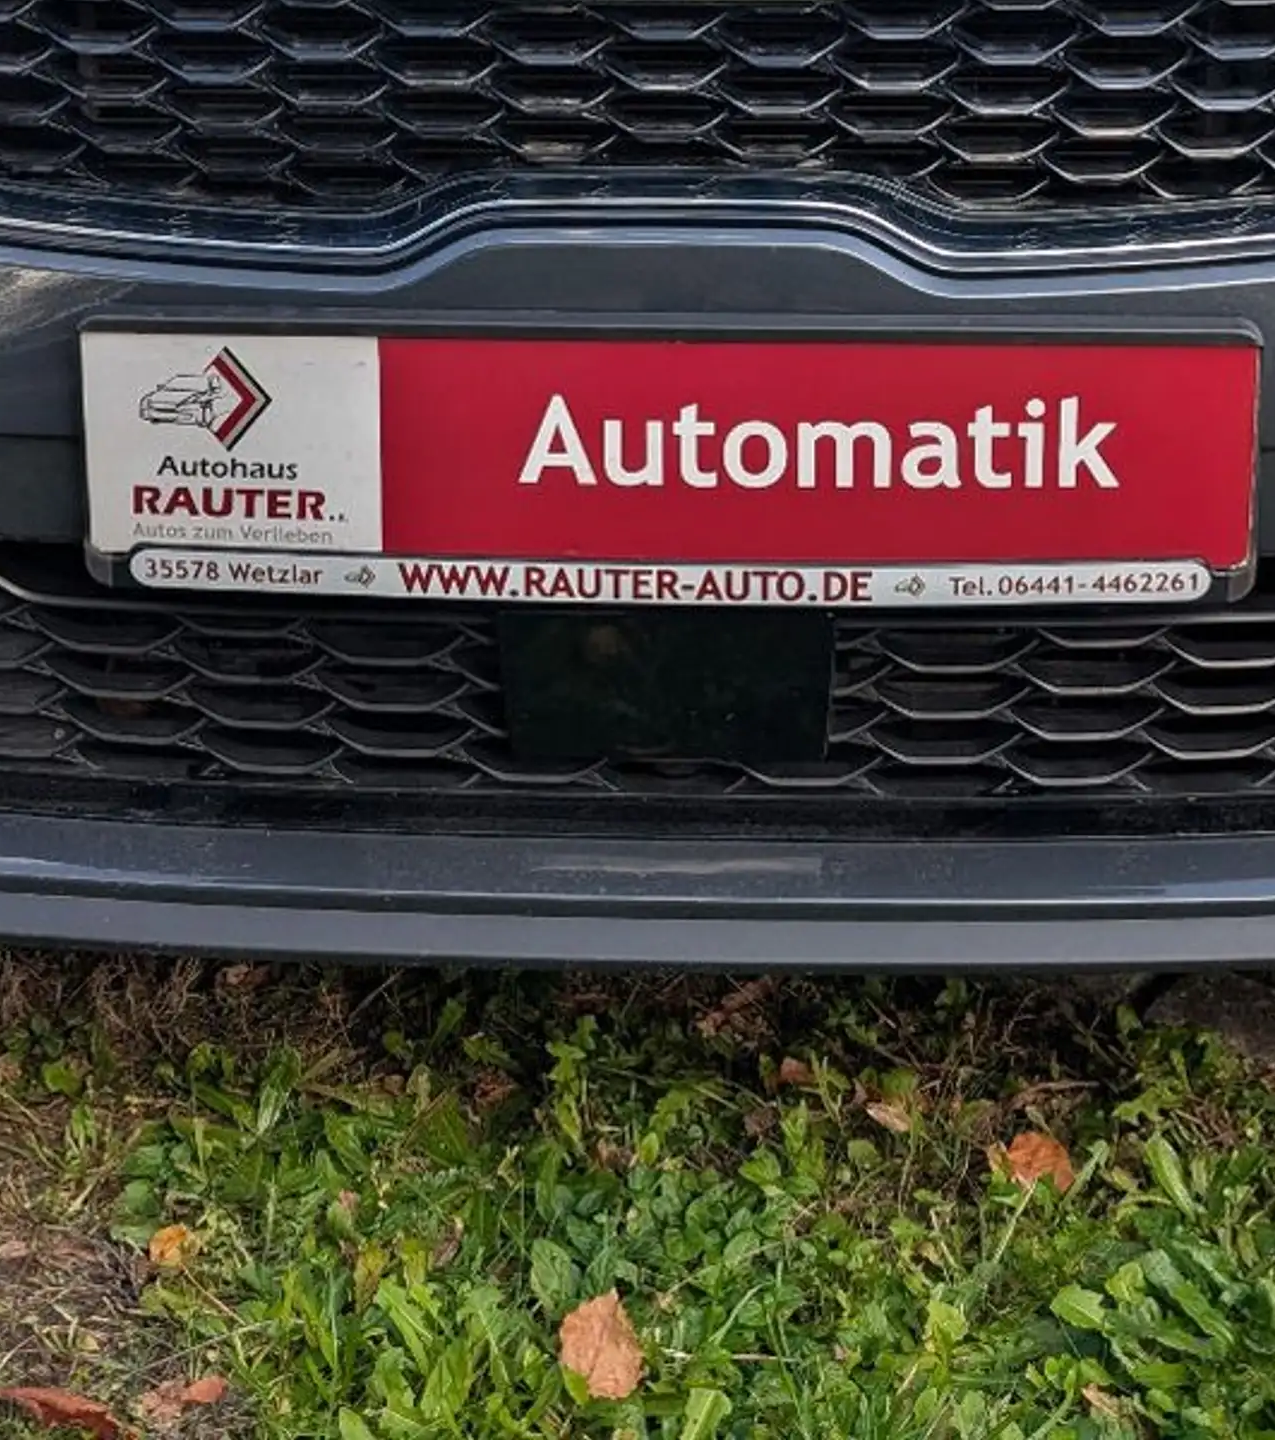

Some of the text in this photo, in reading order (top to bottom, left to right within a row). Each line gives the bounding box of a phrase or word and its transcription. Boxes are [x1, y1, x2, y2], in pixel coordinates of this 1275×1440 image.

[517, 392, 1121, 490] Automatik
[156, 455, 299, 480] Autohaus
[131, 484, 326, 521] RAUTER
[132, 521, 334, 545] Autos zum Verlieben
[144, 558, 221, 581] 35578
[228, 561, 325, 586] Wetzlar
[398, 562, 874, 603] WWW.RAUTER-AUTO.DE
